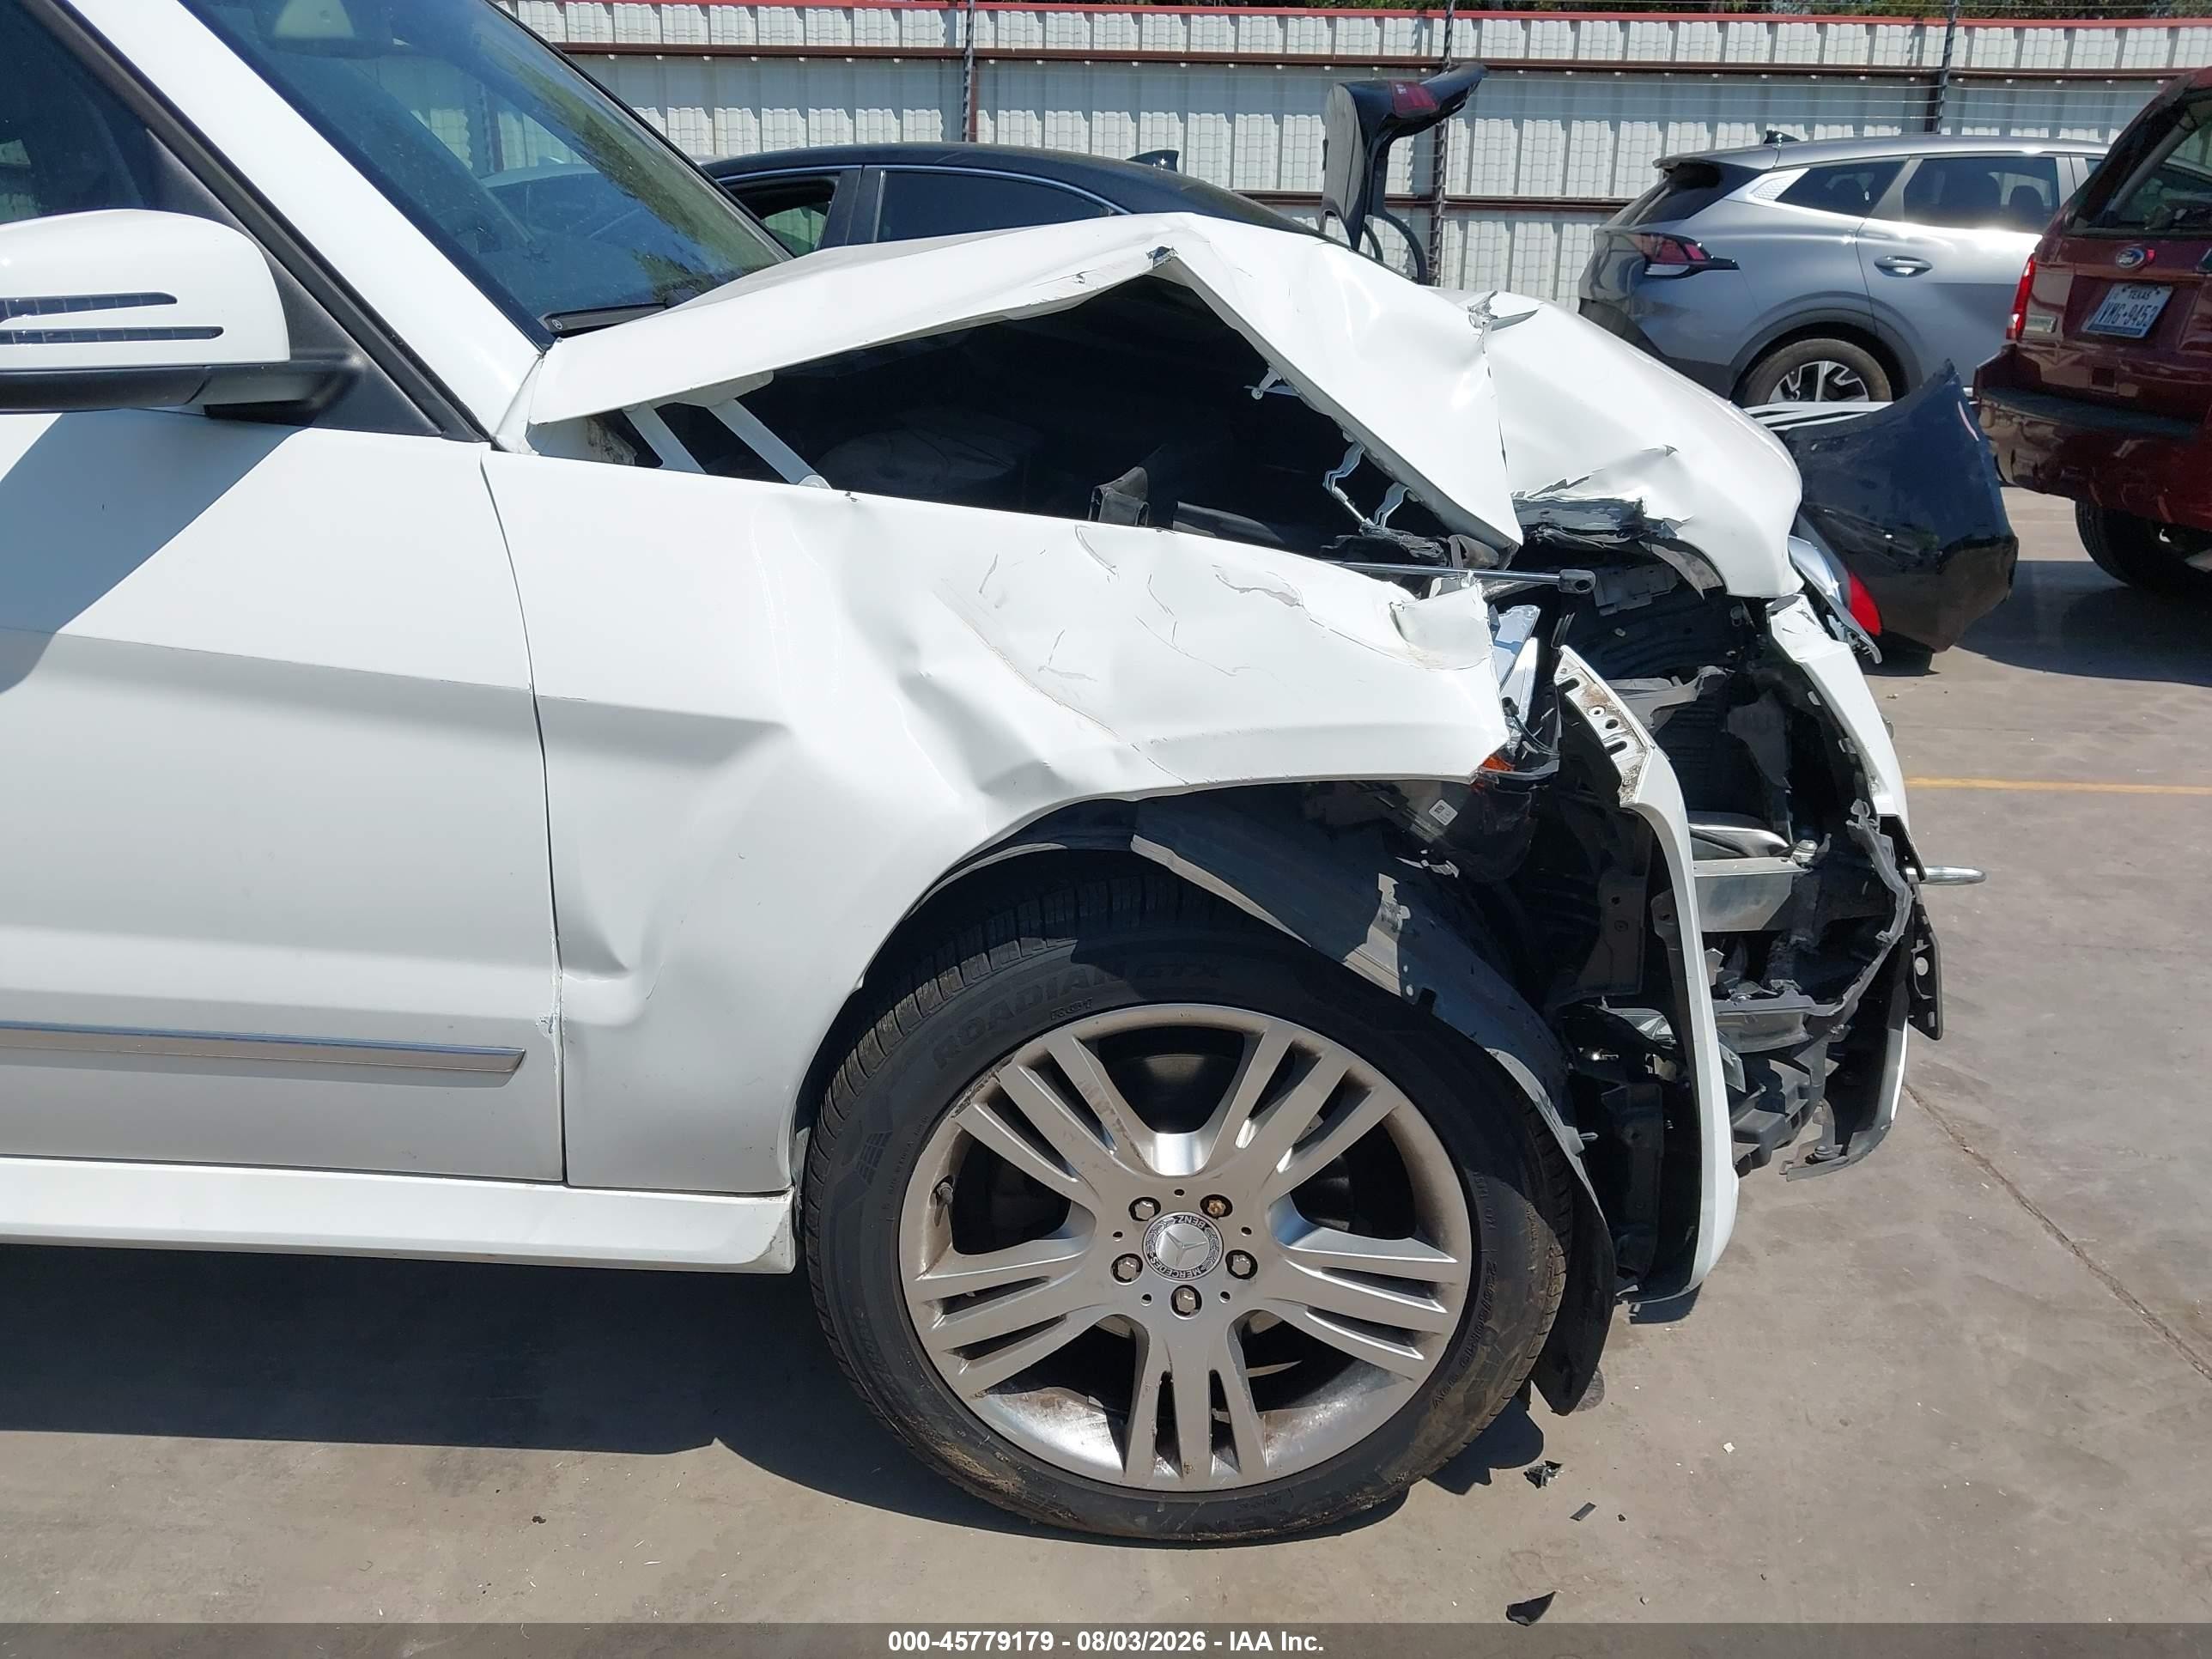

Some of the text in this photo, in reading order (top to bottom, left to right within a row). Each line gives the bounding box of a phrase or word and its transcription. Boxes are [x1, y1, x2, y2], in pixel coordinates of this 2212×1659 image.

[2129, 290, 2151, 301] TEXAS
[1177, 1215, 1206, 1229] BENZ
[1150, 1256, 1203, 1278] MERCEDES
